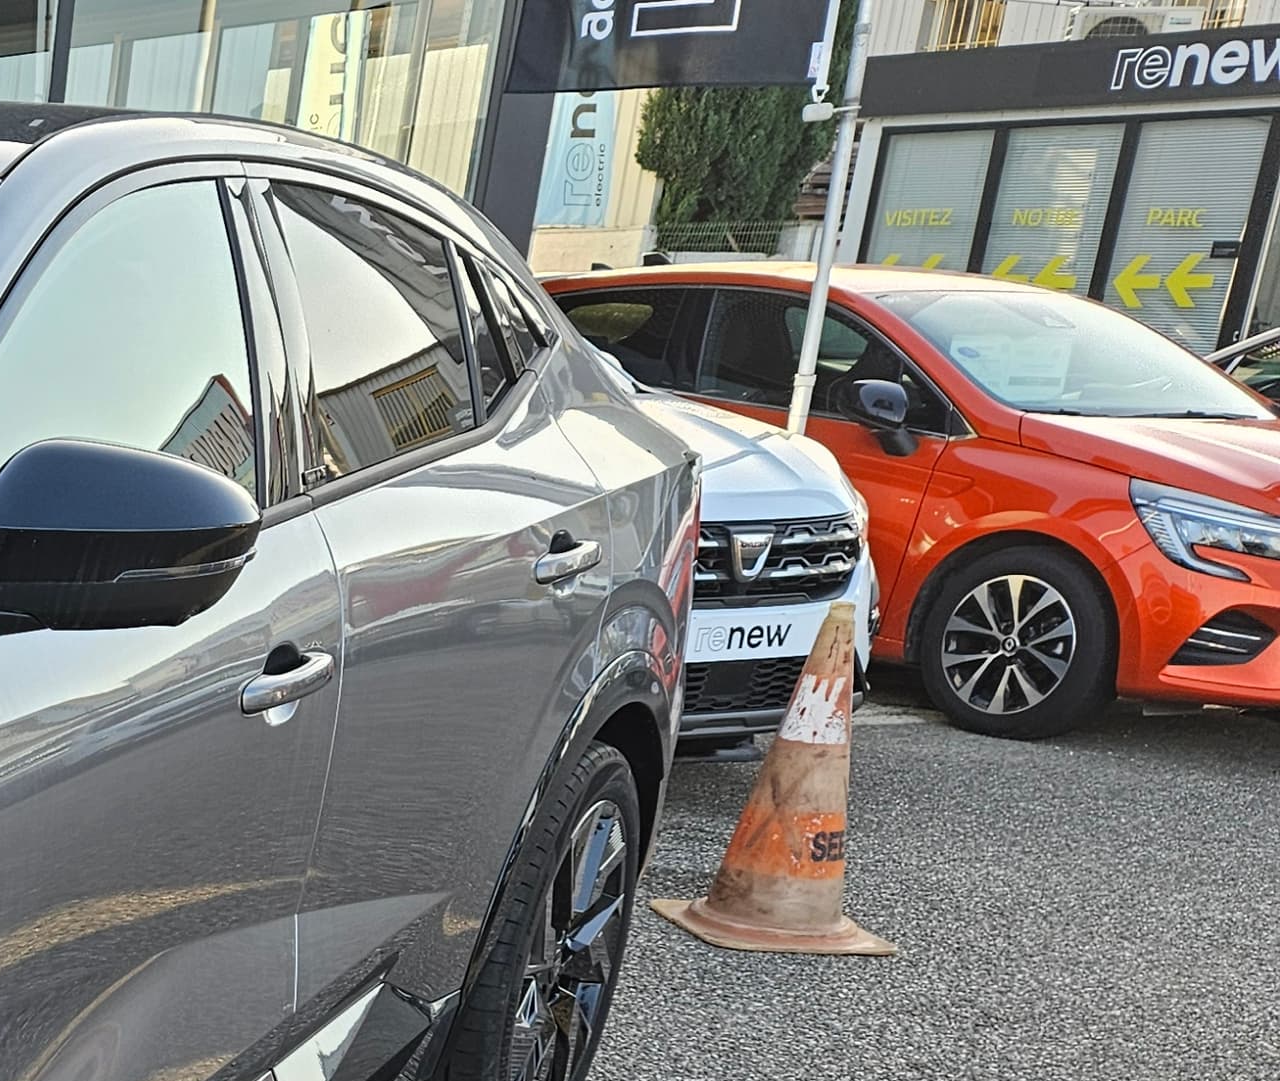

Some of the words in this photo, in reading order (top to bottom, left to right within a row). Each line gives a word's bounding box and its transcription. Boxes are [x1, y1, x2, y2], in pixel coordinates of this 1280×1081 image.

[595, 143, 607, 207] electric
[884, 207, 954, 228] VISITEZ
[1146, 207, 1208, 229] PARC
[694, 623, 793, 653] renew
